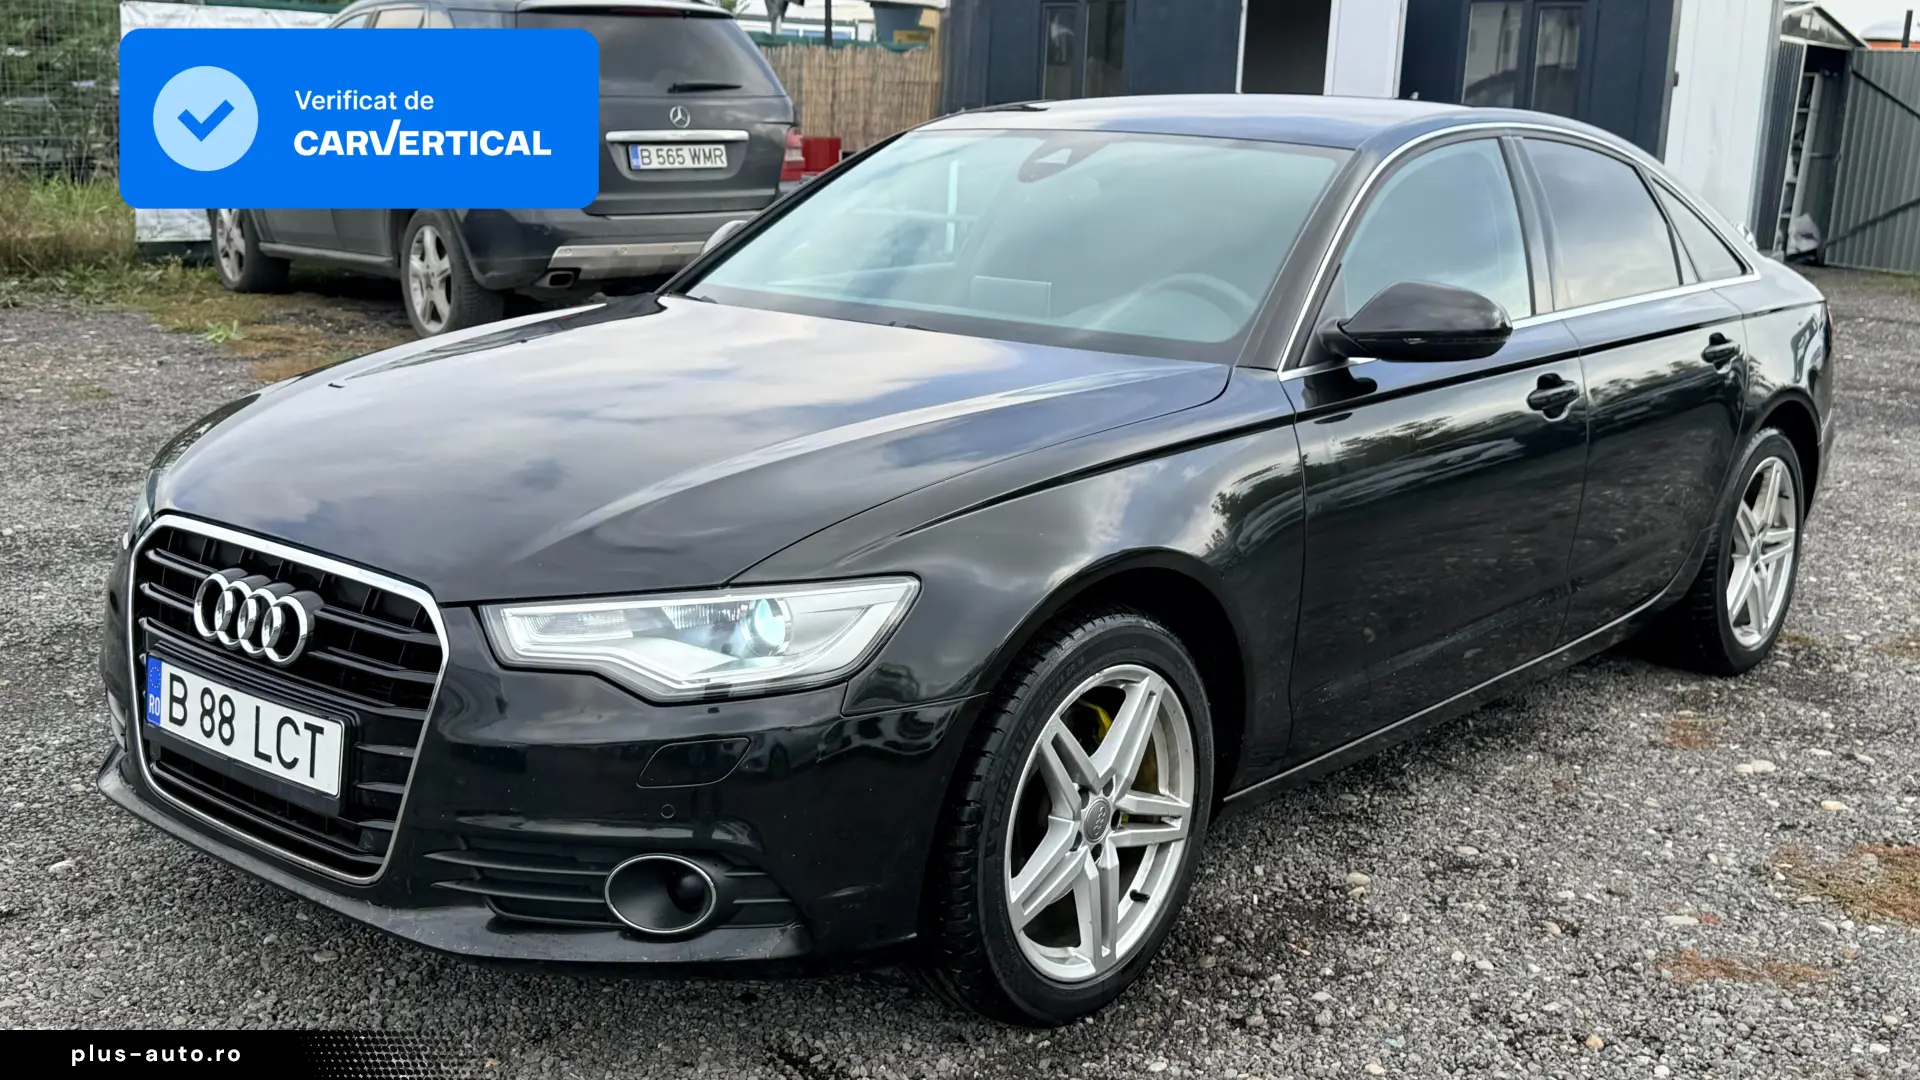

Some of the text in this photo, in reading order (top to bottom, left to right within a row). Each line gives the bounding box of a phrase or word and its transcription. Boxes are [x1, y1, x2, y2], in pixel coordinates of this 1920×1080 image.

[640, 148, 652, 166] B
[656, 148, 686, 165] 565
[688, 147, 725, 165] WMR
[149, 694, 161, 717] RO
[169, 672, 325, 779] B 88 LCT
